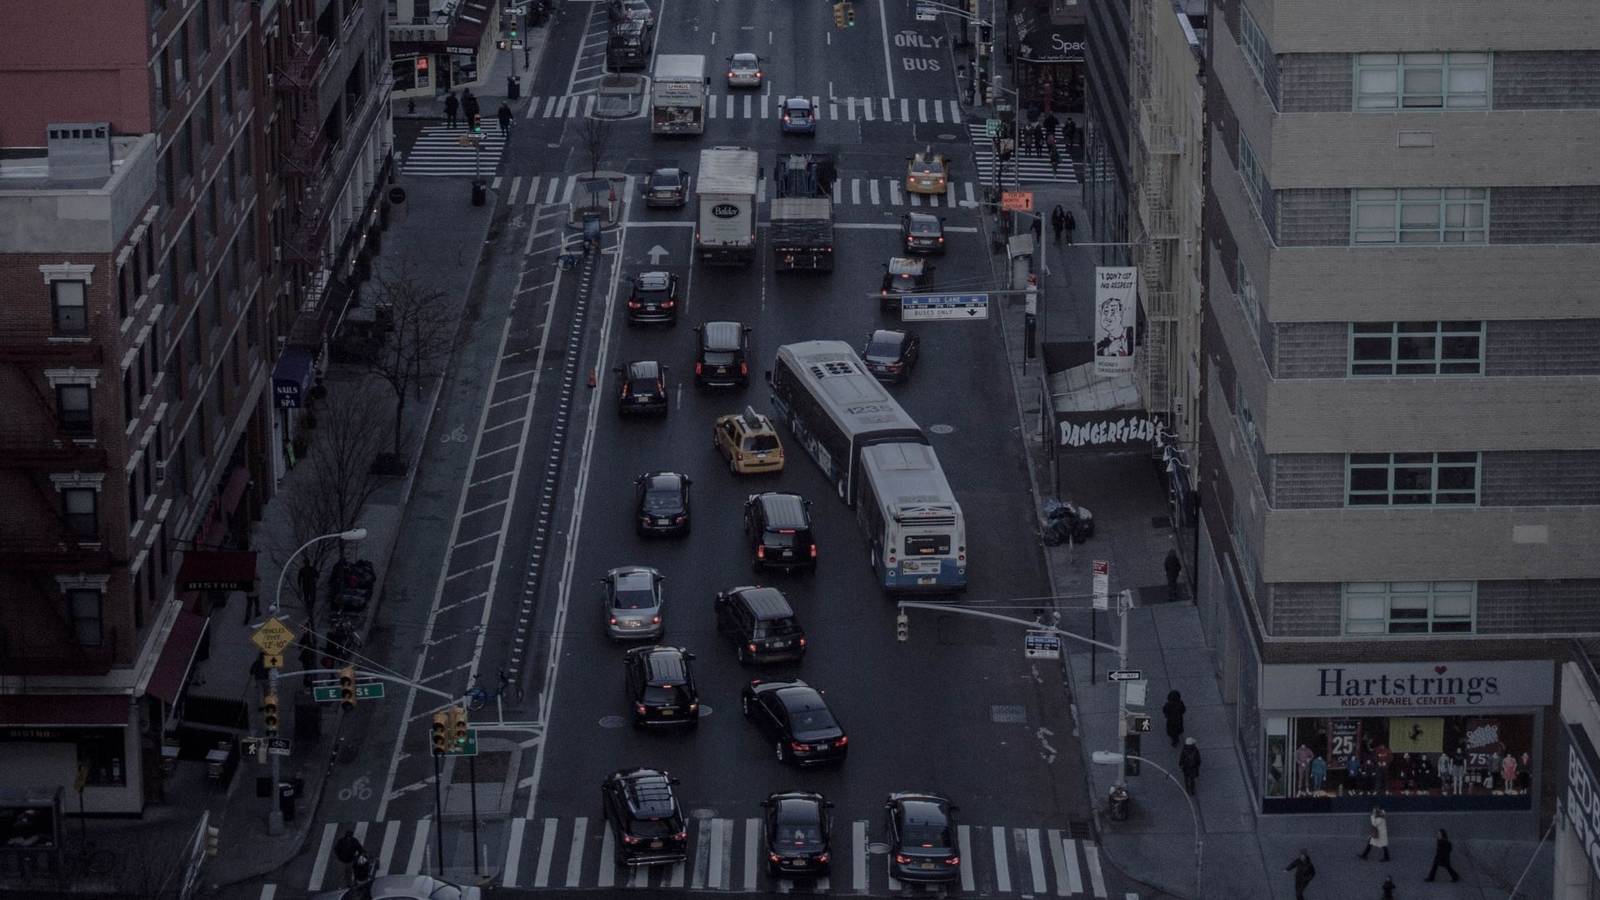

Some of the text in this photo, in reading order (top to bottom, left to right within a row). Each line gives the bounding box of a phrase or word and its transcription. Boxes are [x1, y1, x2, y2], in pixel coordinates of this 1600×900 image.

[895, 34, 944, 48] ONLY
[903, 57, 941, 71] BUS
[189, 581, 238, 590] BISTRO
[329, 687, 369, 698] E St
[1317, 666, 1498, 705] Hartstrings
[1341, 696, 1456, 706] KIDS APPAREL CENTER
[1332, 736, 1353, 754] 25
[1569, 744, 1592, 815] BED
